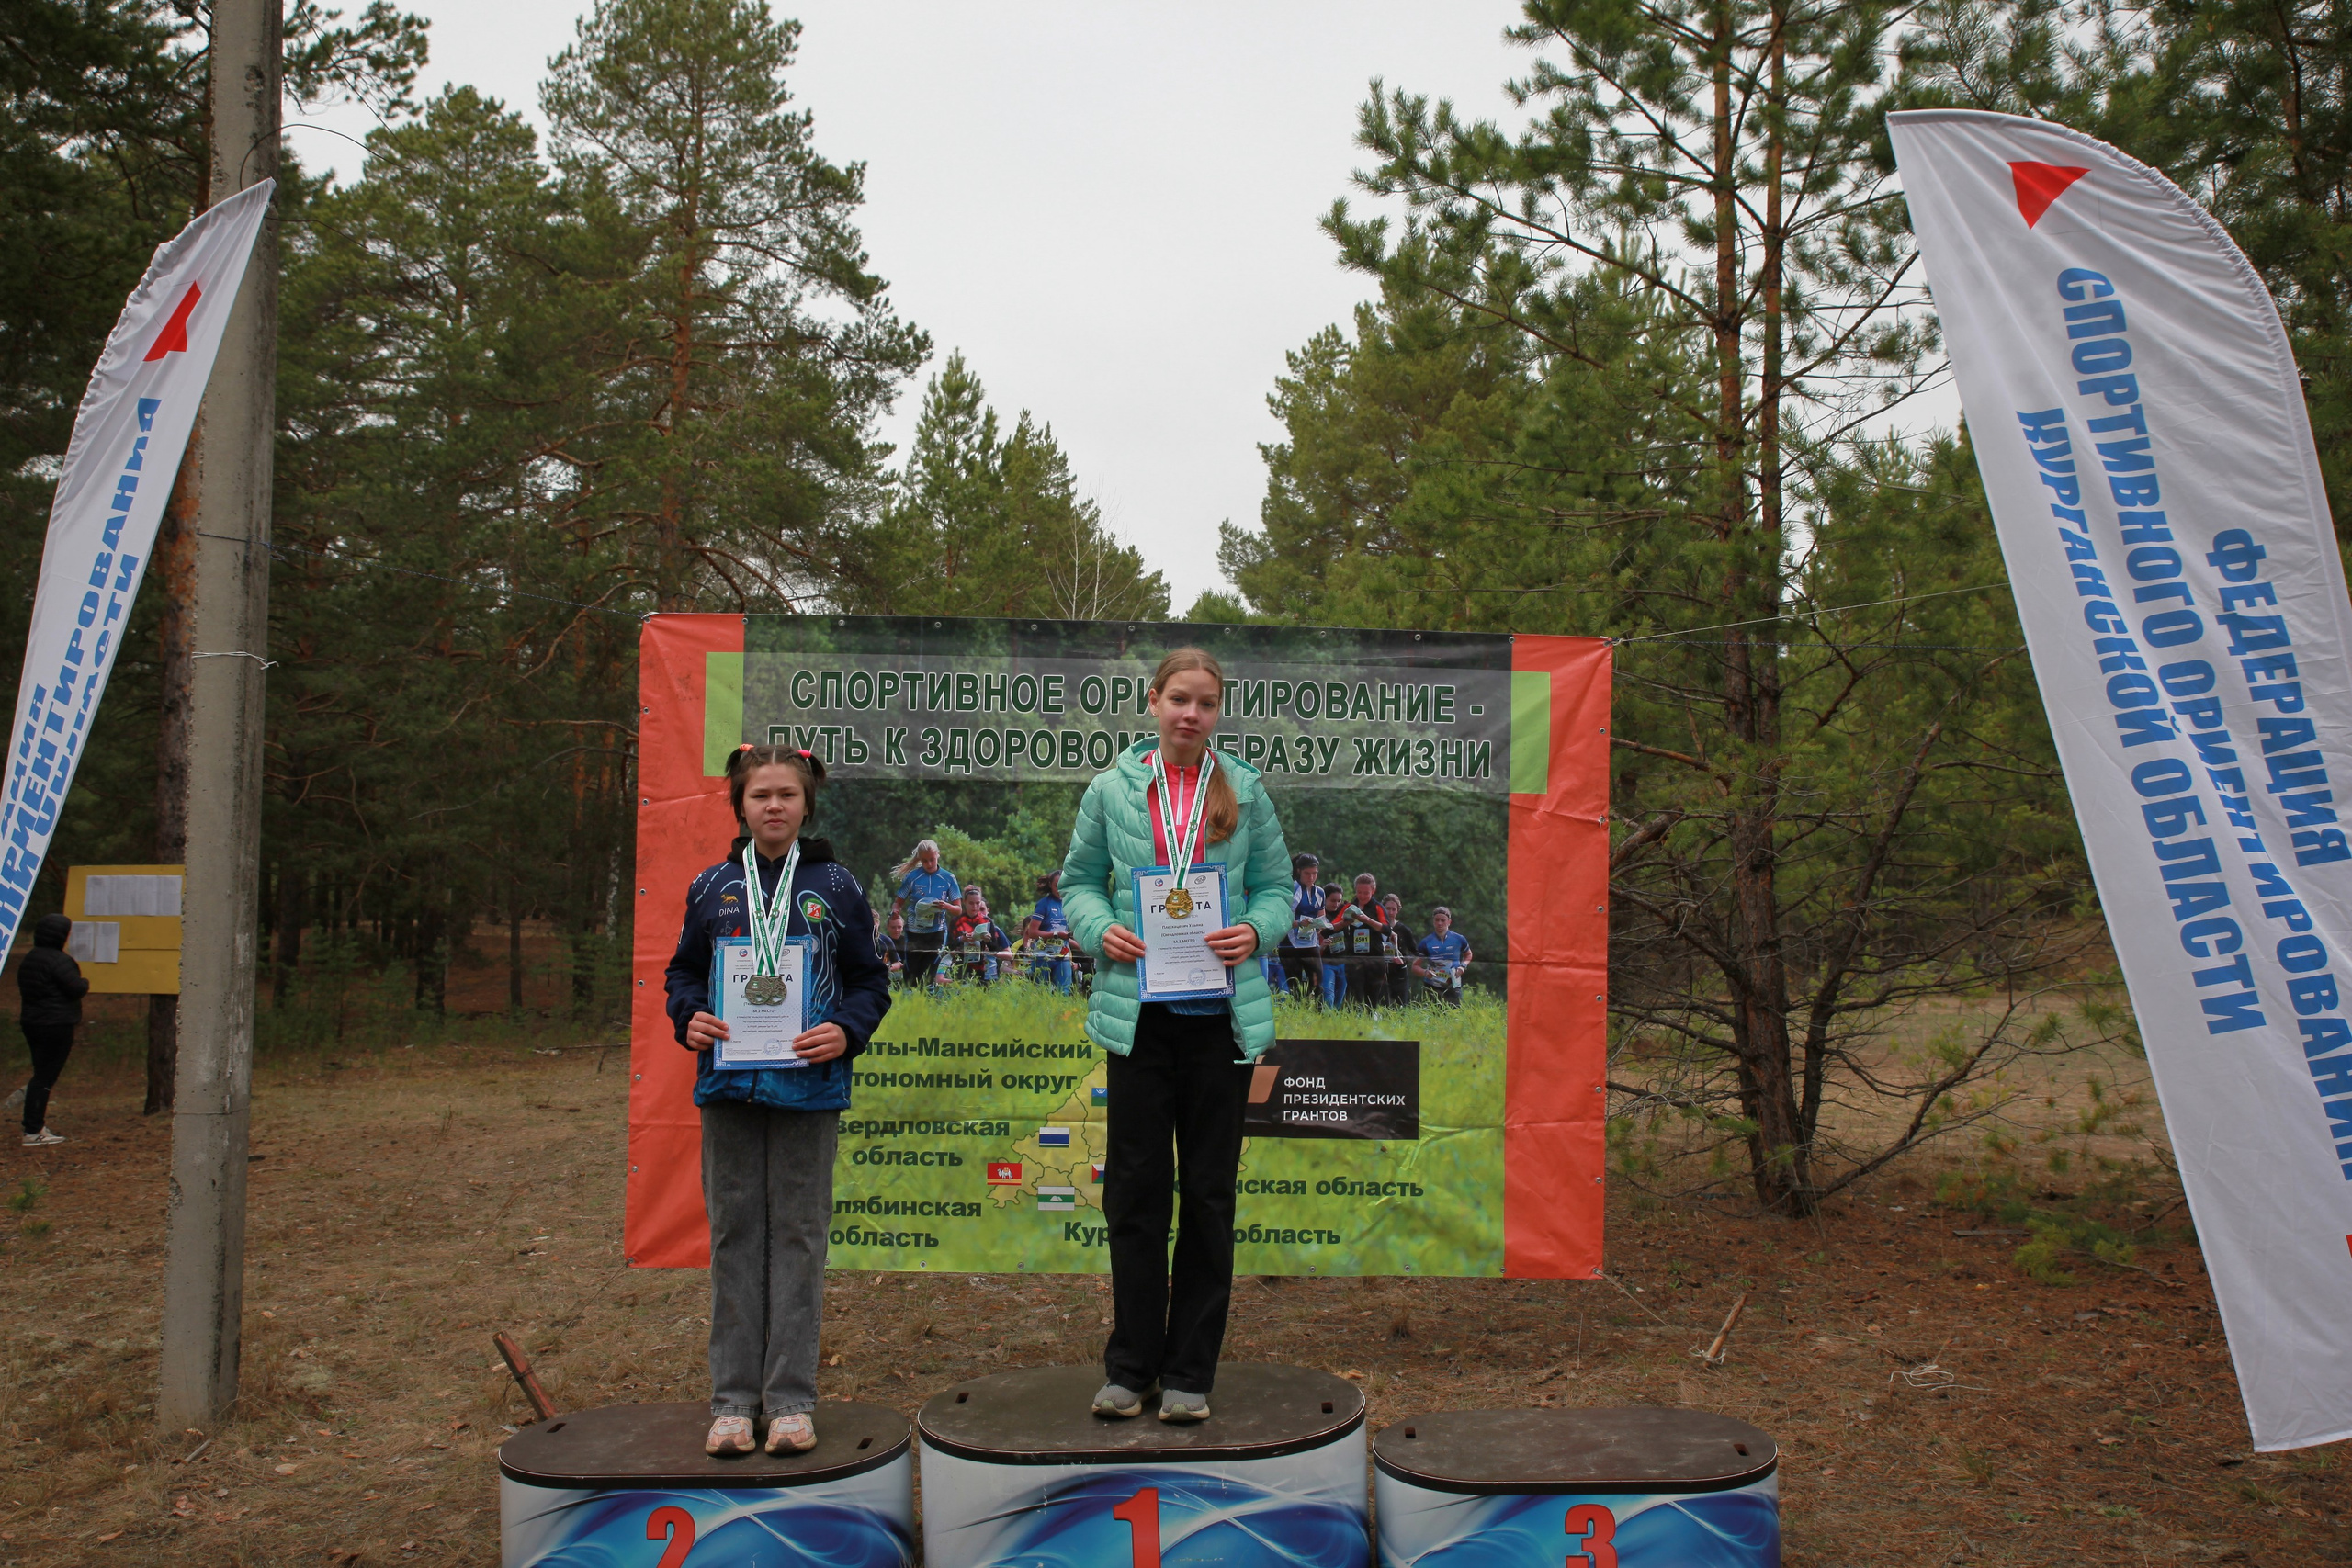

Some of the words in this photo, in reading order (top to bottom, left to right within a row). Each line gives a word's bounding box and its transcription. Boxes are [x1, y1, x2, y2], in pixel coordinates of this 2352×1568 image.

[0, 398, 162, 905] РИЕНТИРОВАНИЯ
[790, 670, 1064, 714] СПОРТИВНОЕ
[1080, 675, 1456, 723] ОРИТИРОВАНИЕ
[2205, 528, 2351, 867] ФЕДЕРАЦИЯ
[2016, 408, 2181, 748] КУРГАНСКОЙ
[2132, 758, 2267, 1035] ОБЛАСТИ
[2057, 267, 2204, 649] СПОРТИВНОГО
[2158, 660, 2352, 1181] ОРИЕНТИРОВАНИ
[767, 724, 869, 764] ПУТЬ
[884, 726, 908, 765] К
[920, 727, 1156, 774] ЗДОРОВОМ
[1206, 733, 1340, 775] БРАЗУ
[1351, 737, 1492, 779] ЖИЗНИ
[718, 906, 740, 917] DINA
[1150, 901, 1212, 913] ГРТА
[860, 1037, 1092, 1059] нты-Мансийский
[853, 1068, 992, 1089] тономный
[1001, 1072, 1078, 1094] округ
[1283, 1077, 1326, 1090] ФОНД
[1283, 1093, 1406, 1107] ПРЕЗИДЕНТСКИХ
[1283, 1110, 1348, 1122] ГРАНТОВ
[838, 1120, 1010, 1139] вердловская
[853, 1145, 963, 1166] область
[1316, 1176, 1424, 1197] область
[833, 1196, 981, 1217] лябинская
[830, 1225, 939, 1247] область
[1234, 1224, 1341, 1245] область
[646, 1506, 695, 1568] 2
[1113, 1487, 1160, 1568] 1
[1565, 1504, 1618, 1568] 3
